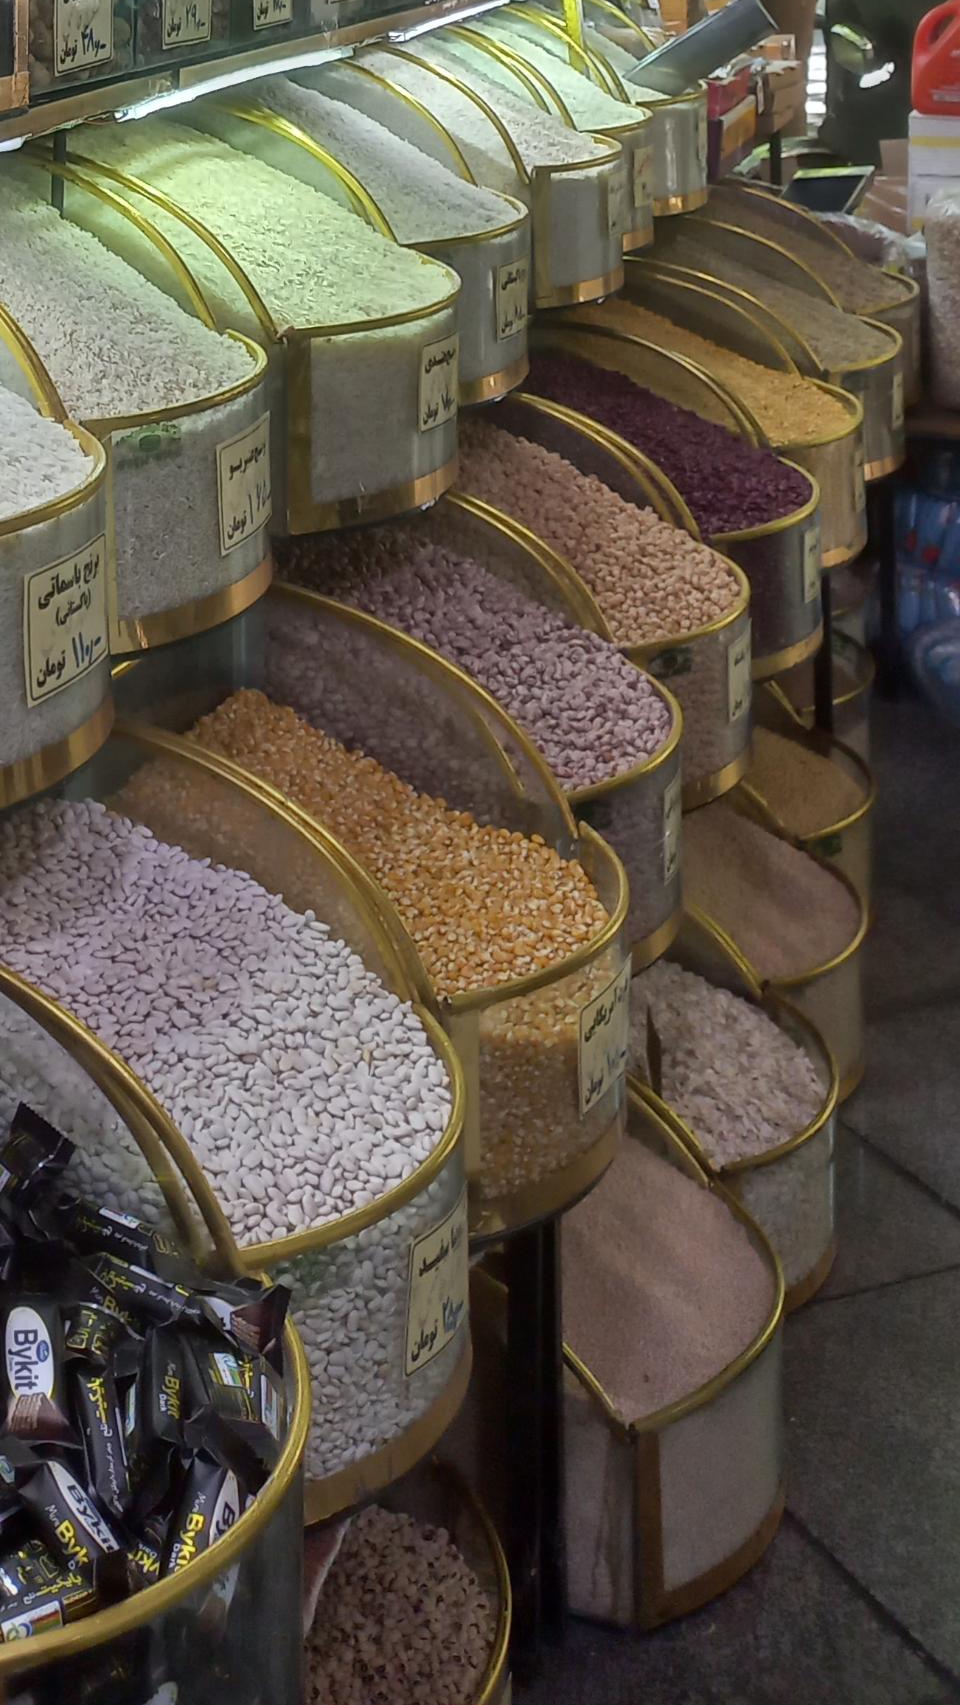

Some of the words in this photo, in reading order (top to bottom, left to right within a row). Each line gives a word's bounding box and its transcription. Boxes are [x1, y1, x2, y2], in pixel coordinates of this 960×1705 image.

[35, 648, 67, 689] تومان
[7, 1328, 40, 1392] Bykit
[56, 1519, 89, 1566] Byk
